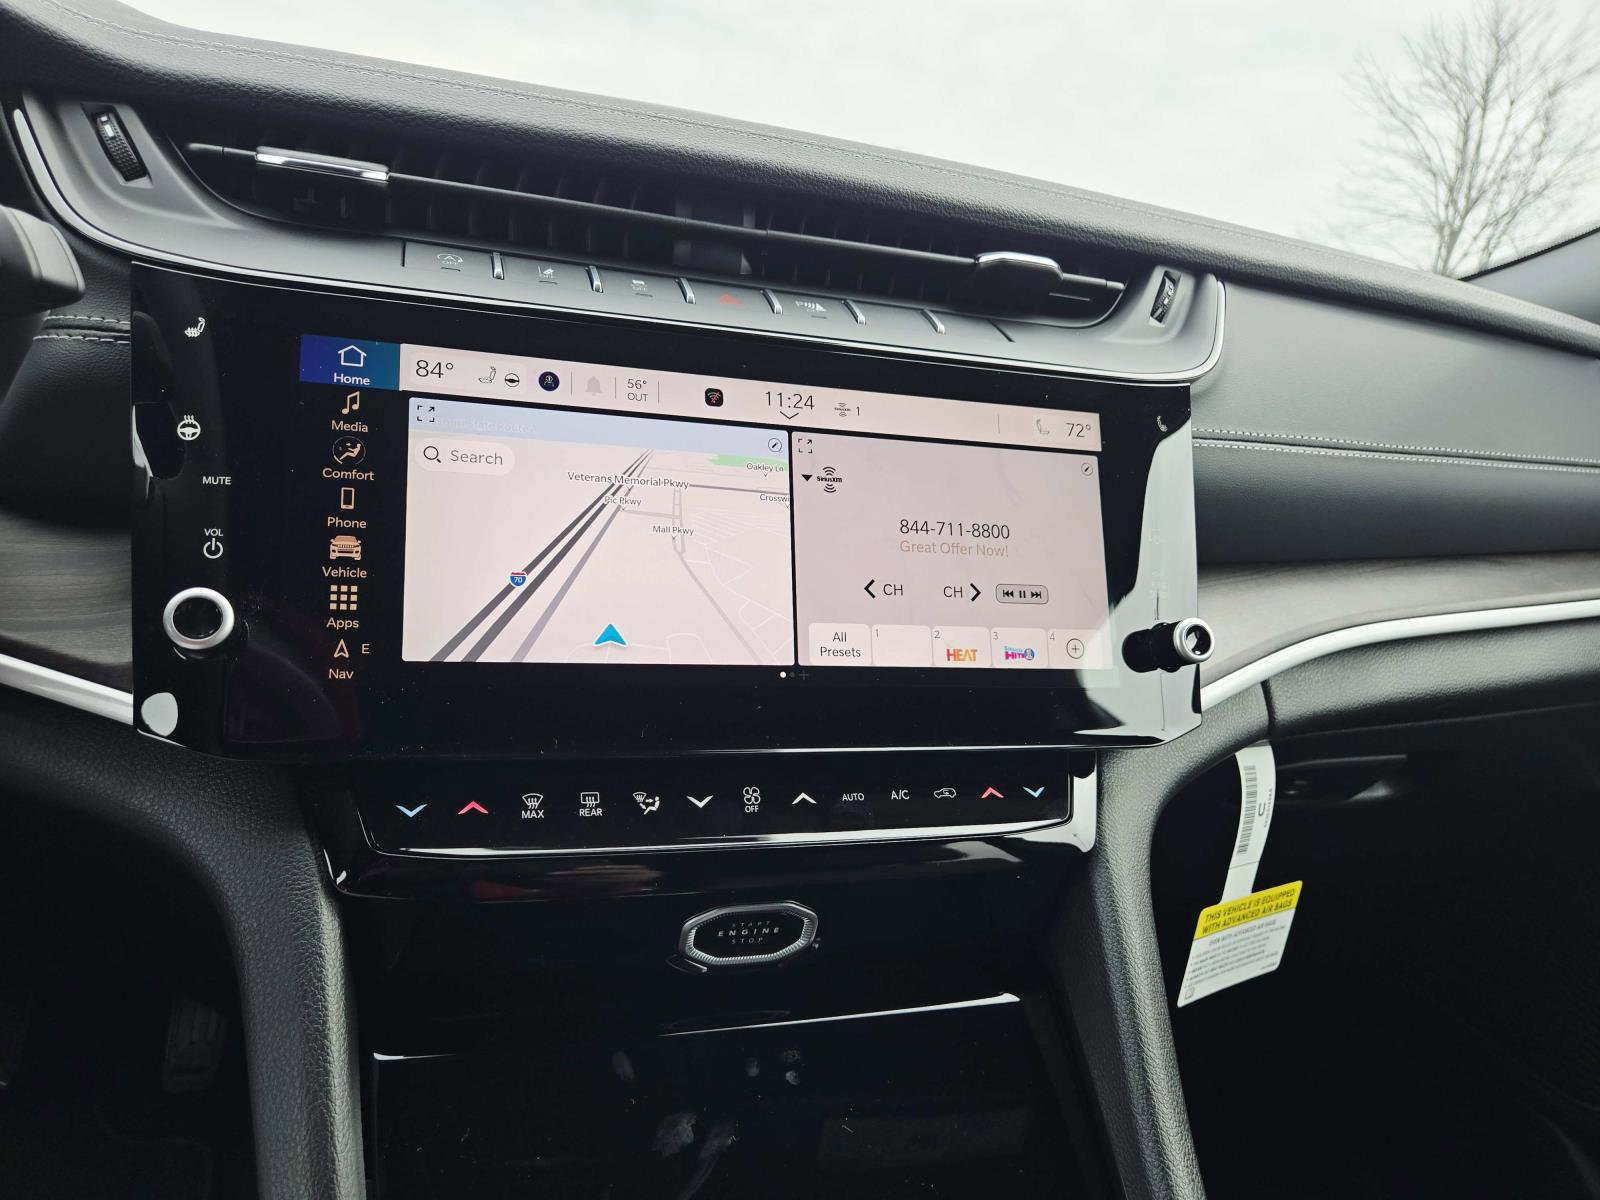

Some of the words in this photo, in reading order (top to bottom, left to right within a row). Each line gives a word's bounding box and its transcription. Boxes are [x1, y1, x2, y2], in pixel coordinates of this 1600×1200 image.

[416, 359, 454, 378] 84°
[333, 372, 370, 385] Home
[627, 378, 647, 390] 56°
[627, 392, 649, 402] OUT
[765, 391, 815, 410] 11:24
[331, 420, 369, 433] Media
[1065, 422, 1091, 438] 72°
[450, 449, 503, 465] Search
[746, 462, 774, 472] Oakley
[322, 467, 375, 481] Comfort
[202, 476, 232, 485] MUTE
[567, 471, 613, 484] Veterans
[614, 475, 661, 487] Memorial
[663, 478, 690, 490] Pkwy
[619, 497, 642, 507] Pkwy
[327, 516, 367, 529] Phone
[204, 528, 223, 537] VOL
[652, 525, 671, 533] Mall
[672, 526, 694, 536] Pkwy
[900, 518, 1010, 540] 844-711-8800
[900, 540, 938, 554] Great
[940, 542, 972, 555] Offer
[976, 544, 1009, 558] Now!
[322, 566, 368, 579] Vehicle
[513, 576, 523, 584] 70
[883, 584, 903, 596] CH
[943, 586, 963, 598] CH
[326, 617, 359, 630] Apps
[832, 631, 847, 642] All
[934, 630, 940, 639] 2
[993, 631, 999, 640] 3
[1049, 632, 1055, 641] 4
[361, 643, 370, 654] E
[820, 646, 861, 657] Presets
[946, 648, 978, 661] HEAT
[328, 668, 354, 679] Nav
[842, 792, 865, 802] AUTO
[891, 790, 910, 800] A/C
[521, 810, 545, 819] MAX
[579, 808, 603, 817] REAR
[745, 805, 759, 813] OFF
[1205, 910, 1221, 923] THIS
[1223, 899, 1252, 917] VEHICLE
[1261, 888, 1296, 904] EQUIPPED
[1202, 920, 1221, 935] WITH
[1222, 908, 1261, 926] ADVANCED
[1262, 903, 1273, 914] AIR
[1274, 899, 1292, 911] BAGS
[731, 920, 771, 928] START
[718, 927, 780, 937] ENGINE
[731, 937, 763, 945] STOP
